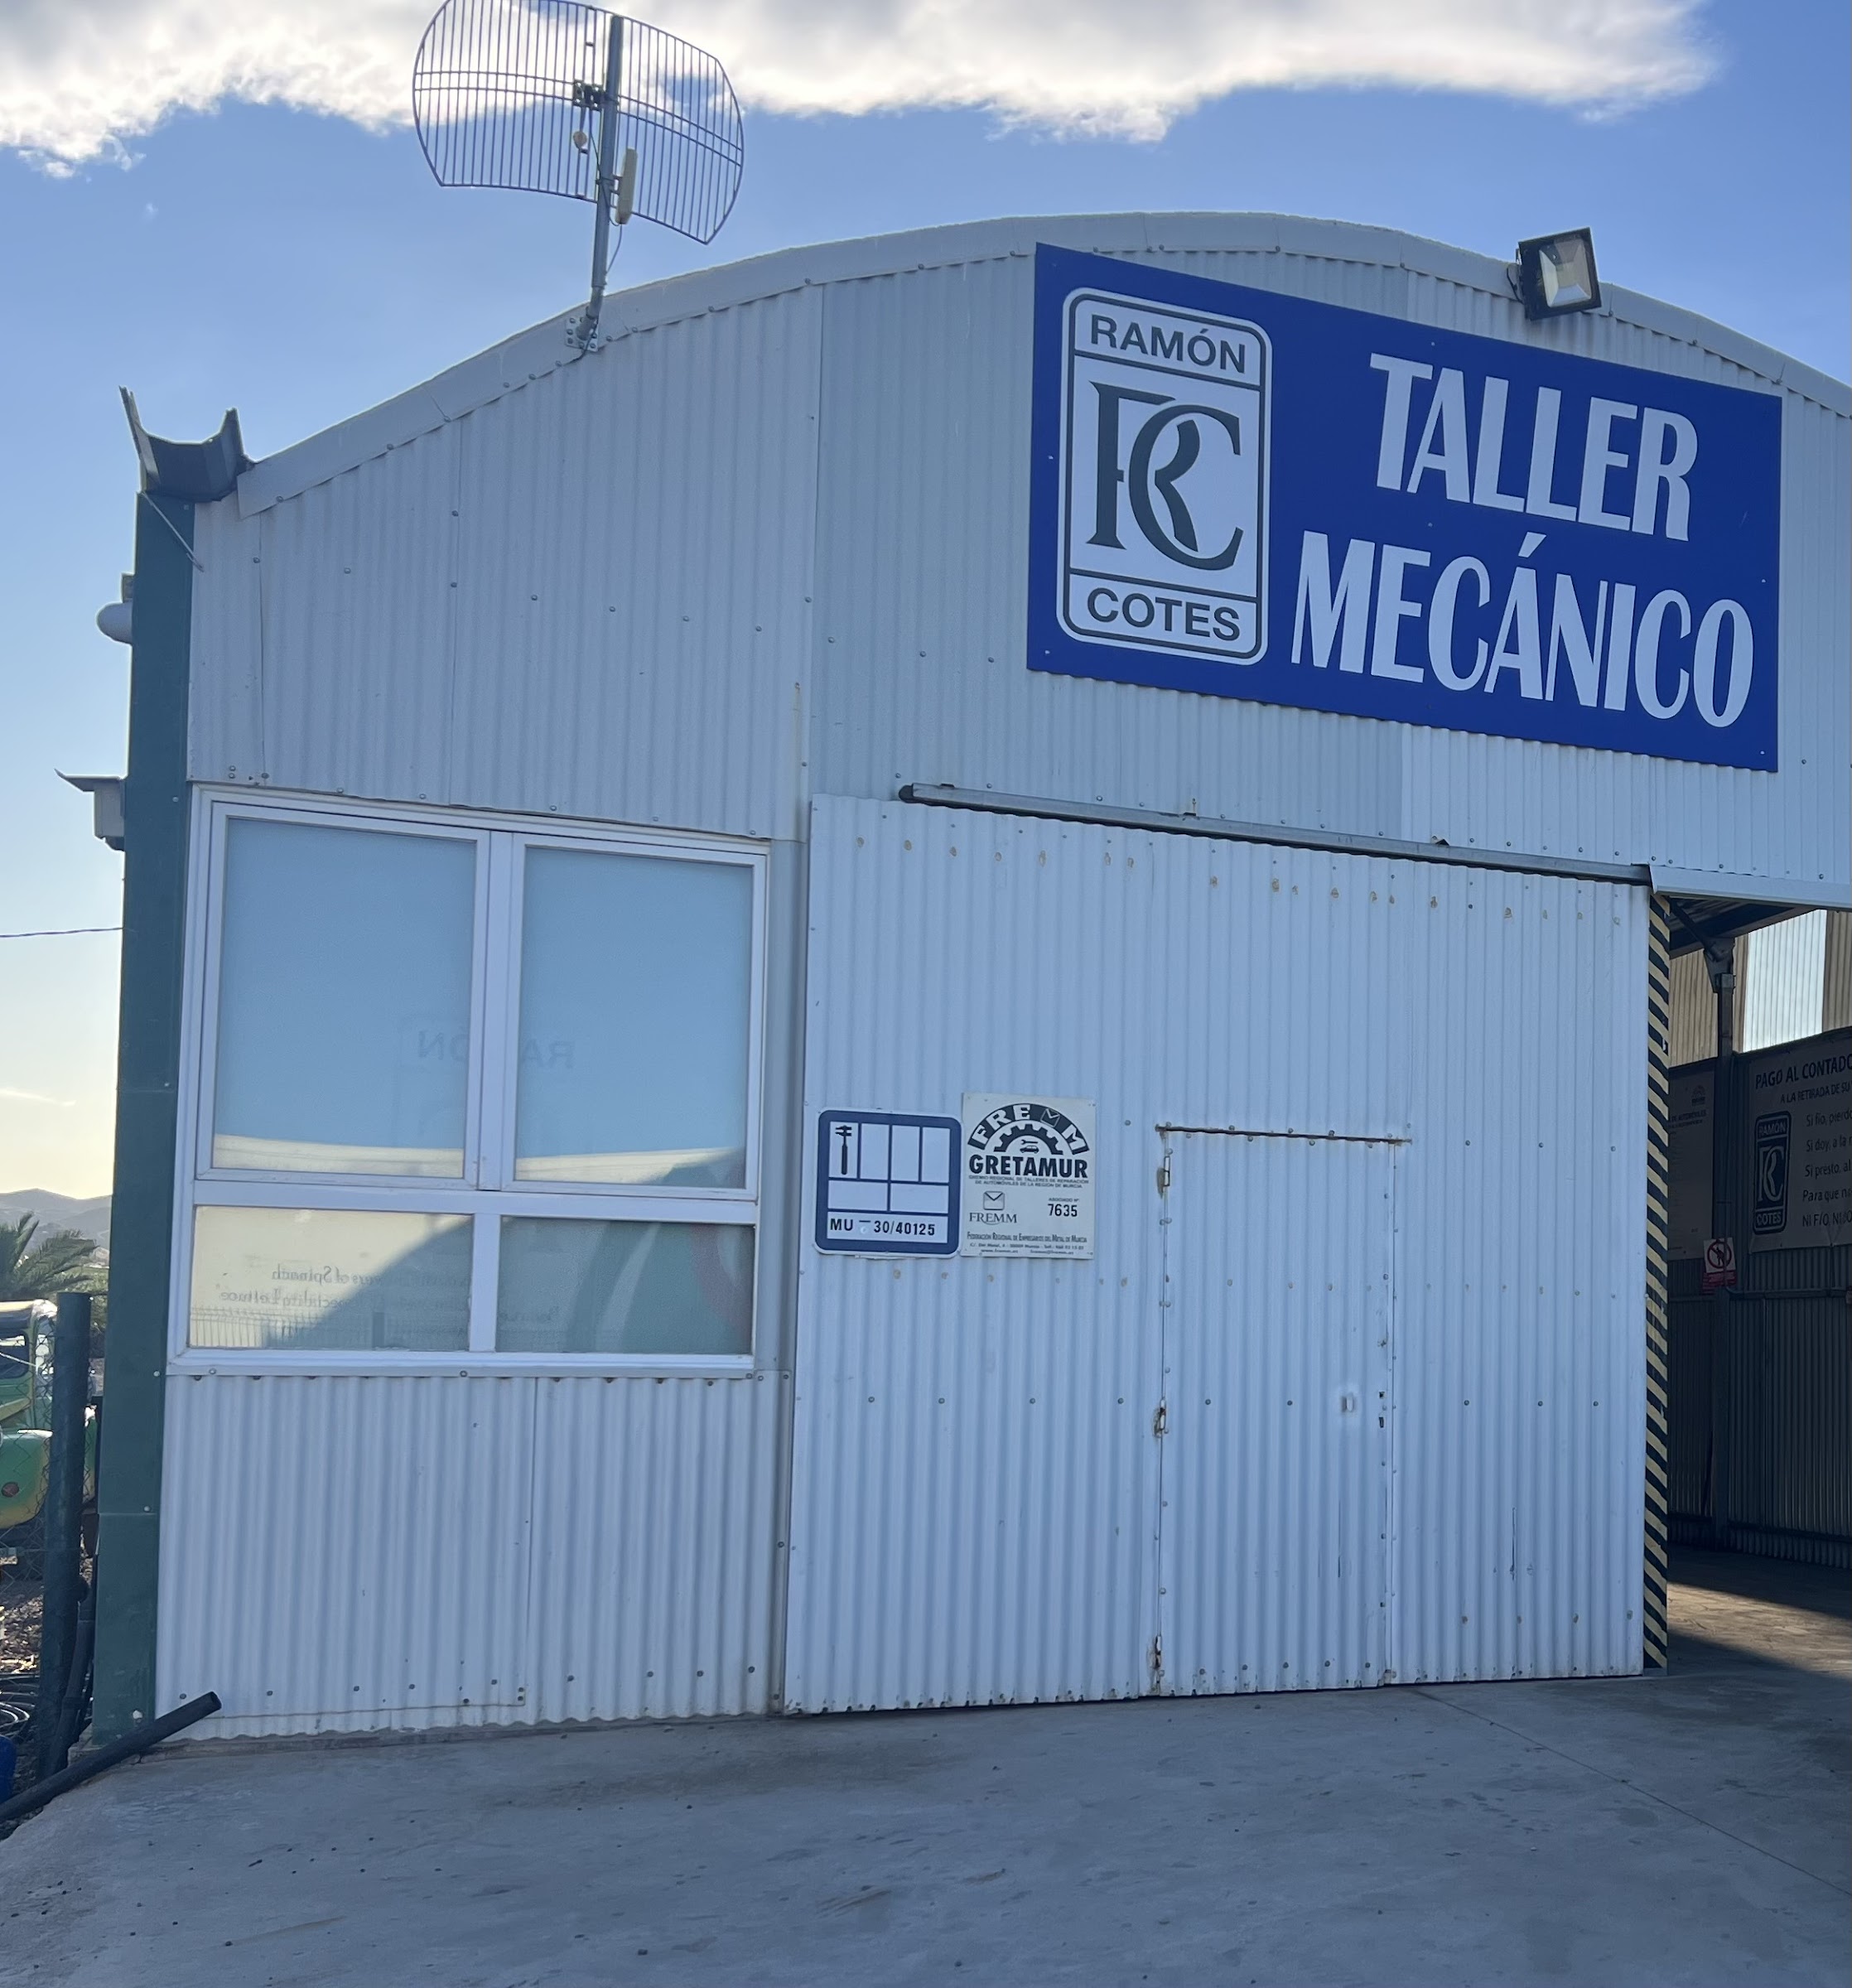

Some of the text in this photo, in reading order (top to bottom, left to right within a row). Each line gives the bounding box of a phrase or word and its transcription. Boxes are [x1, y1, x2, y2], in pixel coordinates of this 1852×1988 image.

[1090, 314, 1246, 374] RAMÓN
[1370, 352, 1698, 542] TALLER
[1087, 586, 1241, 642] COTES
[1290, 530, 1754, 728] MECÁNICO
[1755, 1069, 1783, 1089] PAGO
[1785, 1066, 1799, 1083] AL
[1780, 1081, 1850, 1103] A LA RETIRADA DE SU
[1758, 1121, 1787, 1137] RAMÓN
[969, 1155, 1088, 1179] GRETAMUR
[1802, 1189, 1823, 1202] Para
[969, 1213, 1017, 1225] FREMM
[1048, 1204, 1078, 1217] 7635
[1756, 1213, 1781, 1226] COTES
[830, 1218, 853, 1231] MU
[874, 1220, 935, 1236] 30/40125
